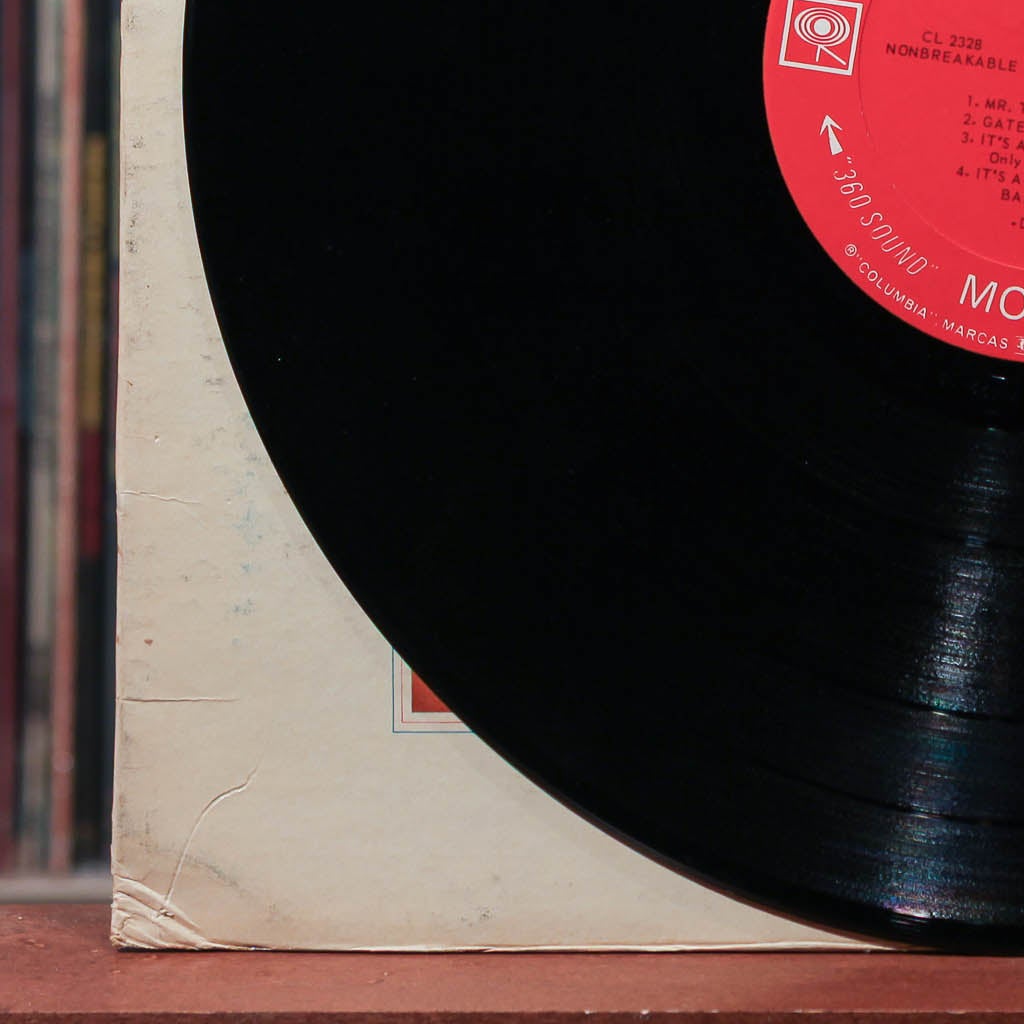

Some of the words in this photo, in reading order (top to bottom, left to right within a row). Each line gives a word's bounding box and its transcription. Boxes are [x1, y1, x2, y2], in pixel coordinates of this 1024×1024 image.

[922, 31, 943, 45] CL
[949, 34, 983, 50] 2328
[886, 43, 1017, 72] NONBREAKABLE
[985, 98, 1012, 113] MR.
[981, 134, 1010, 149] IT'S
[989, 152, 1022, 169] Only
[976, 168, 1005, 183] IT'S
[942, 319, 1008, 349] MARCAS
